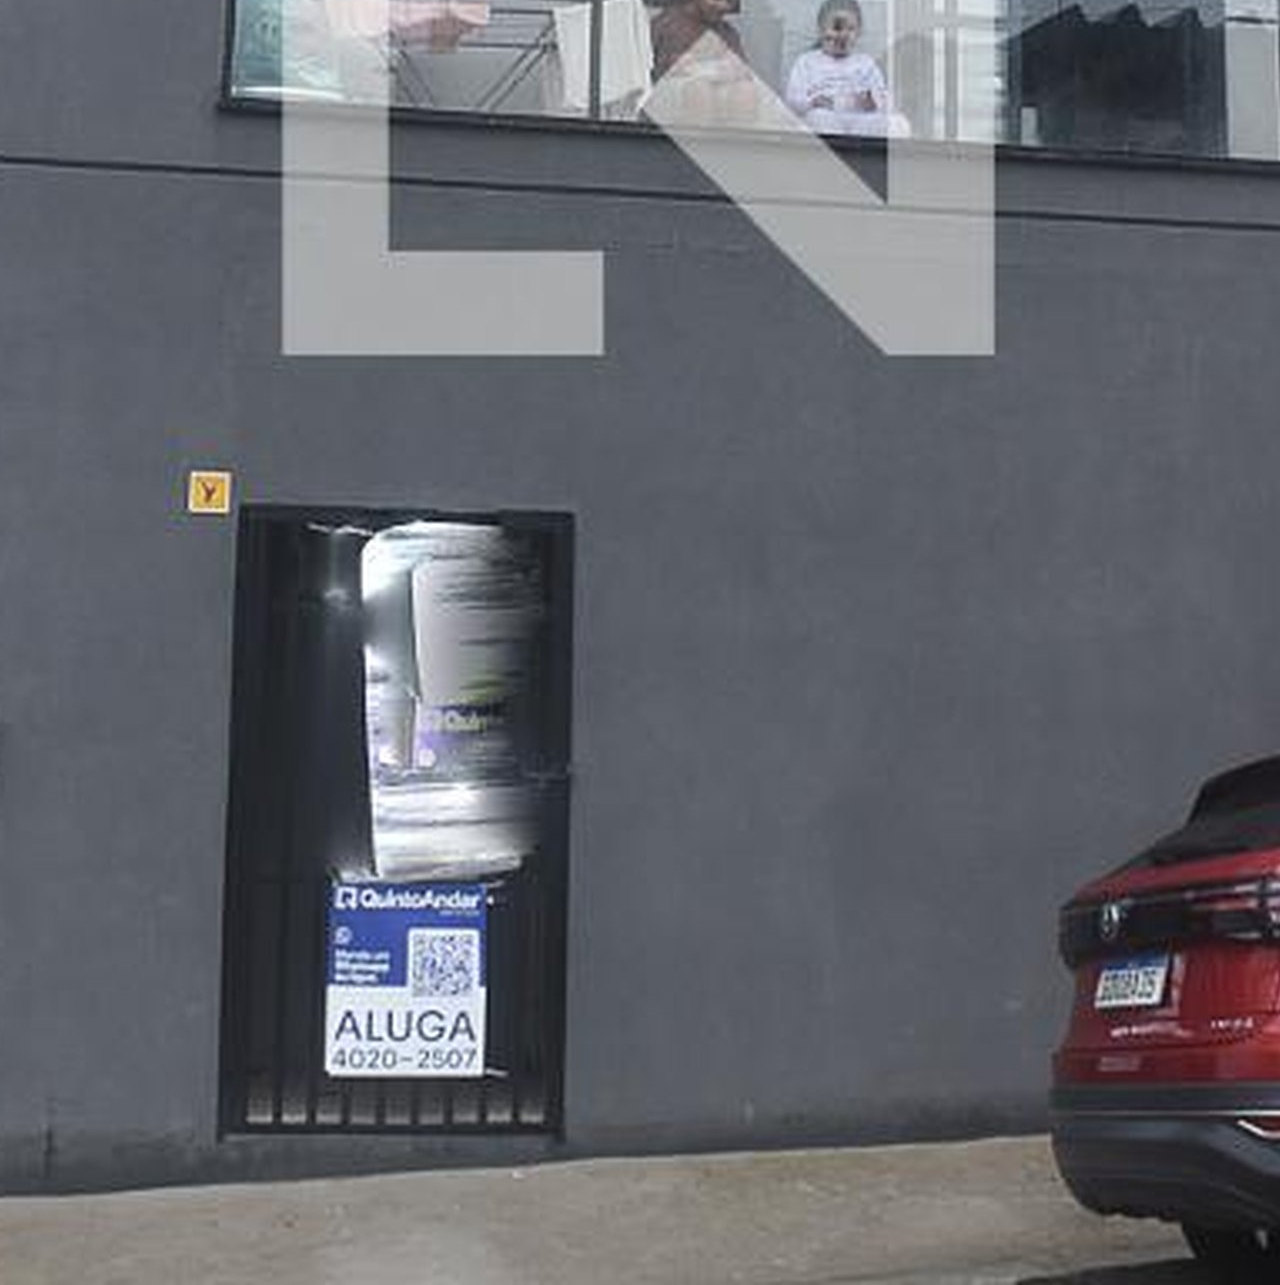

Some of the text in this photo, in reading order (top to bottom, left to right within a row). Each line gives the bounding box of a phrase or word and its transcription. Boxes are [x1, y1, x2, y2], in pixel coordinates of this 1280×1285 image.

[360, 887, 480, 909] QuintoAndar
[334, 1010, 476, 1043] ALUGA
[331, 1048, 478, 1069] 4020-2507
